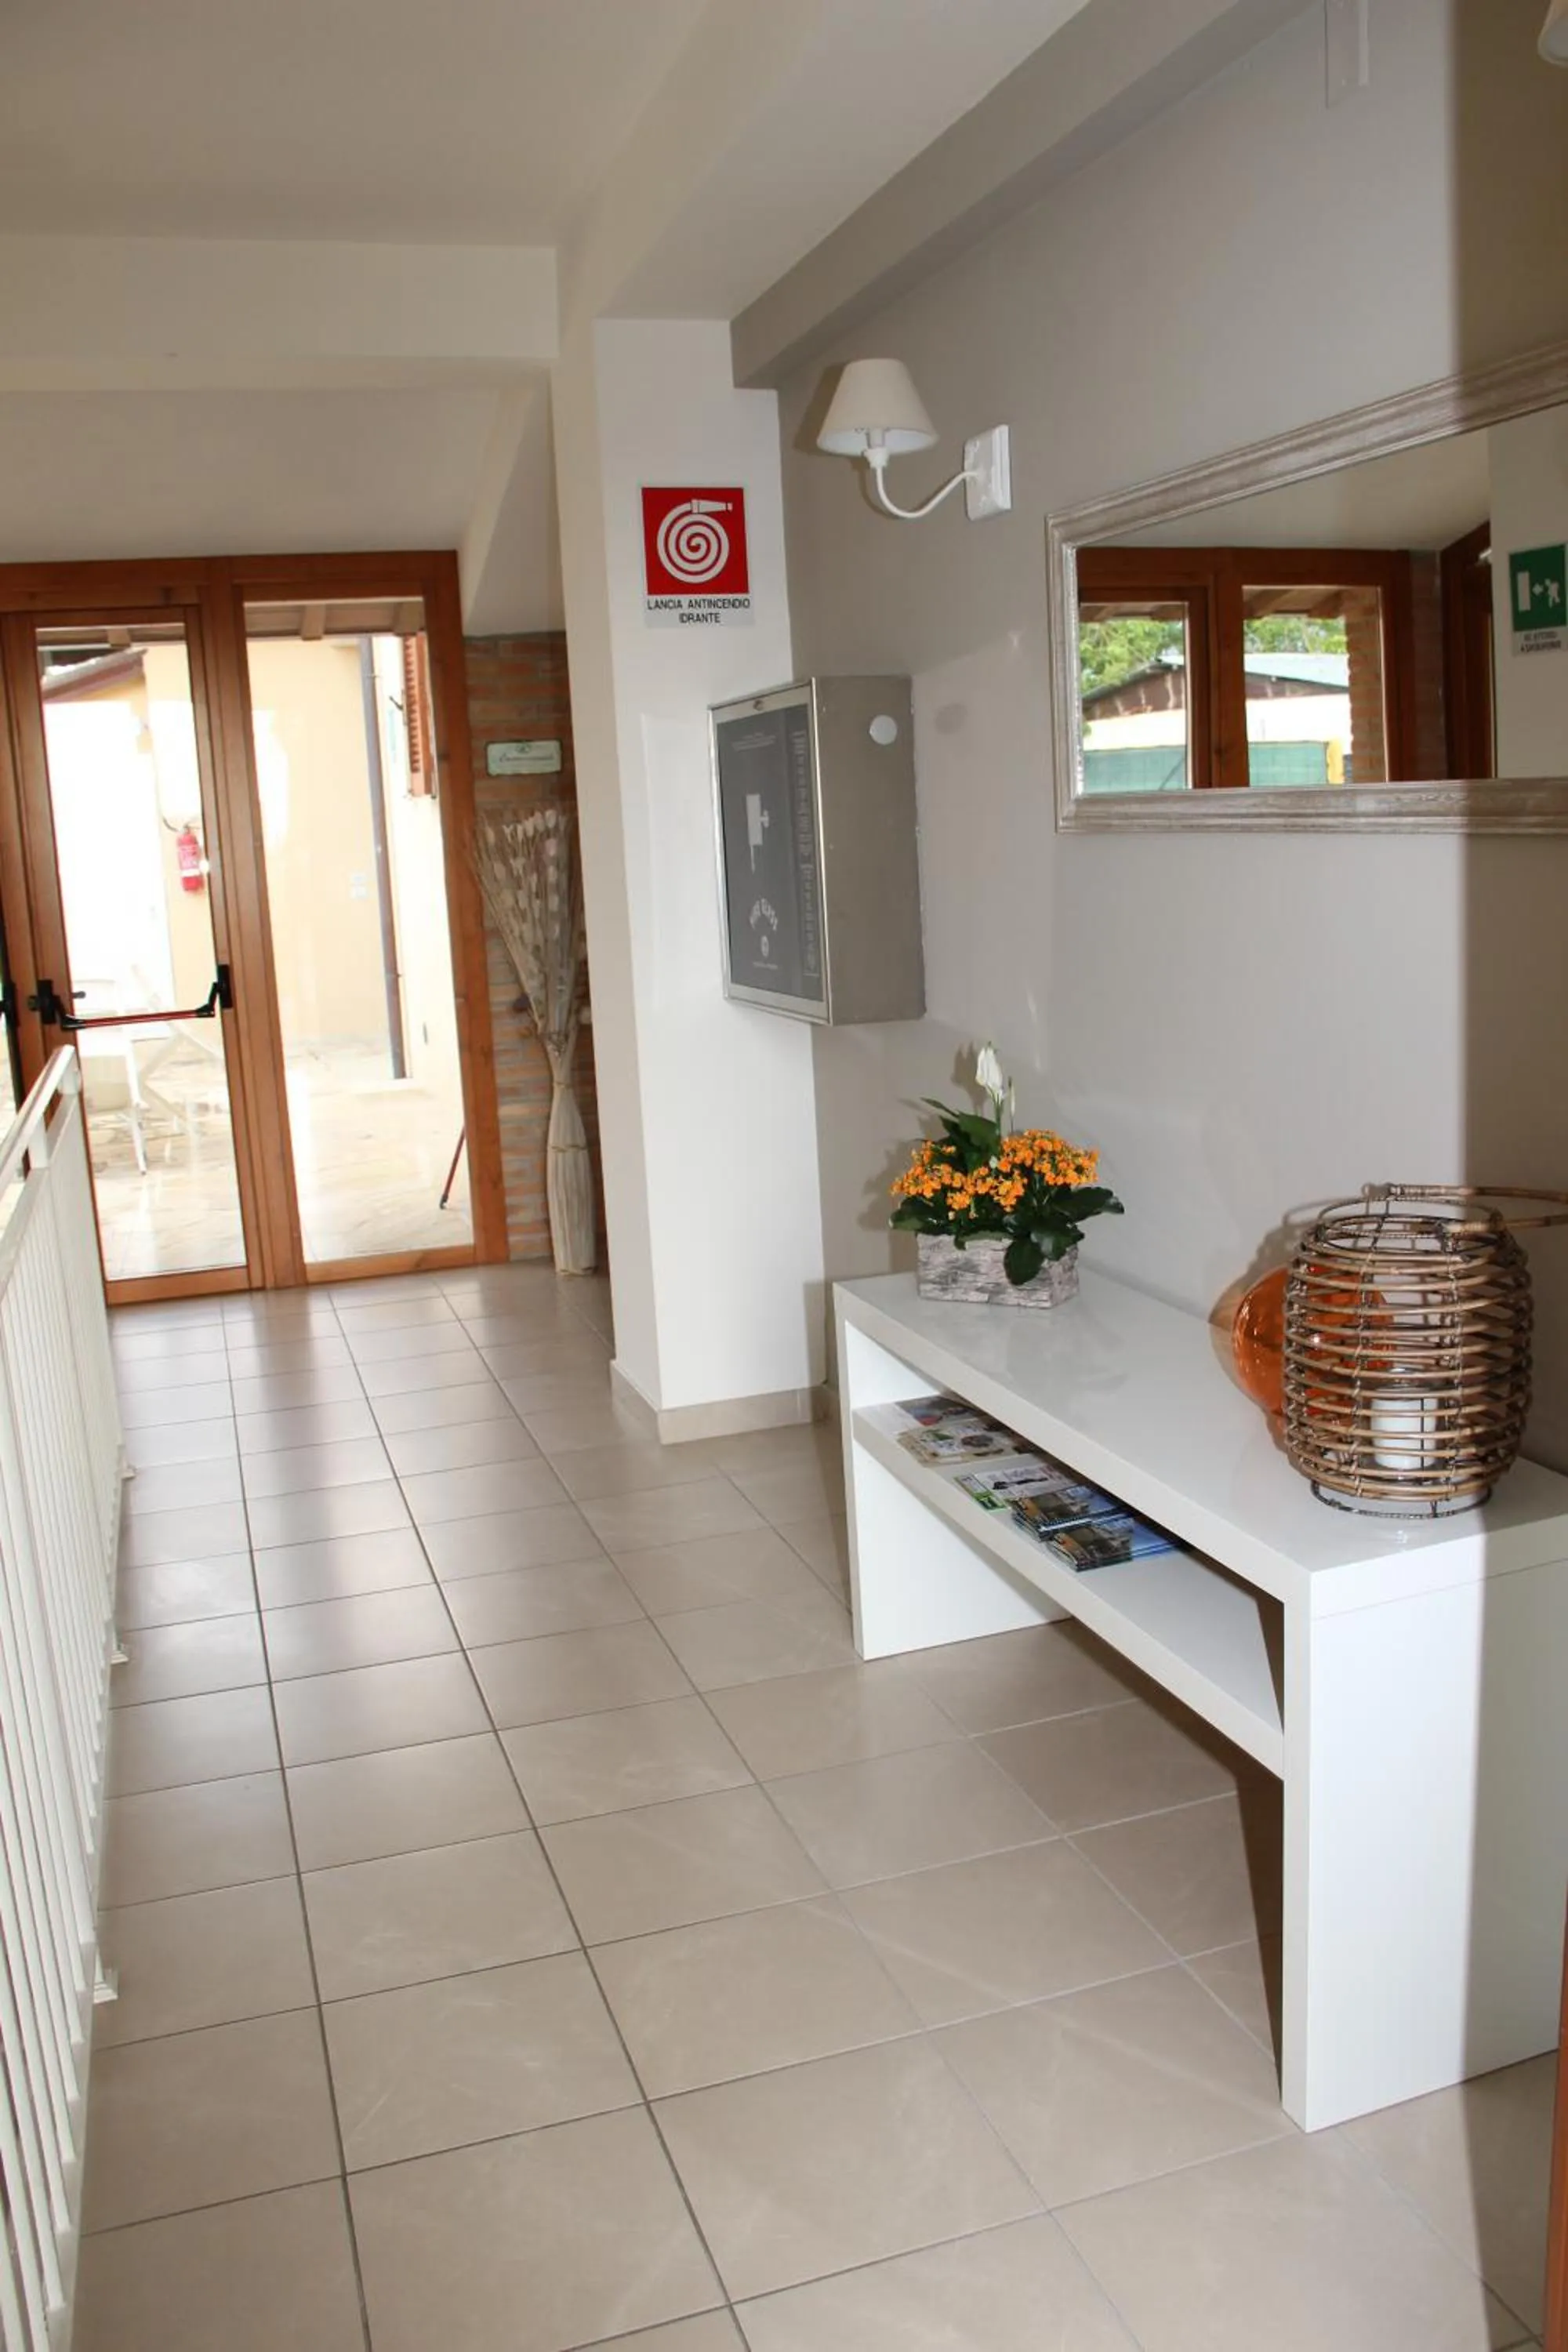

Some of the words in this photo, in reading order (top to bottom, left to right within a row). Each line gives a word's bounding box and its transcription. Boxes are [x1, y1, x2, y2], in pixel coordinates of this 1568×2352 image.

[648, 599, 683, 610] LANCIA
[688, 598, 750, 609] ANTINCENDIO
[678, 613, 720, 623] IDRANTE
